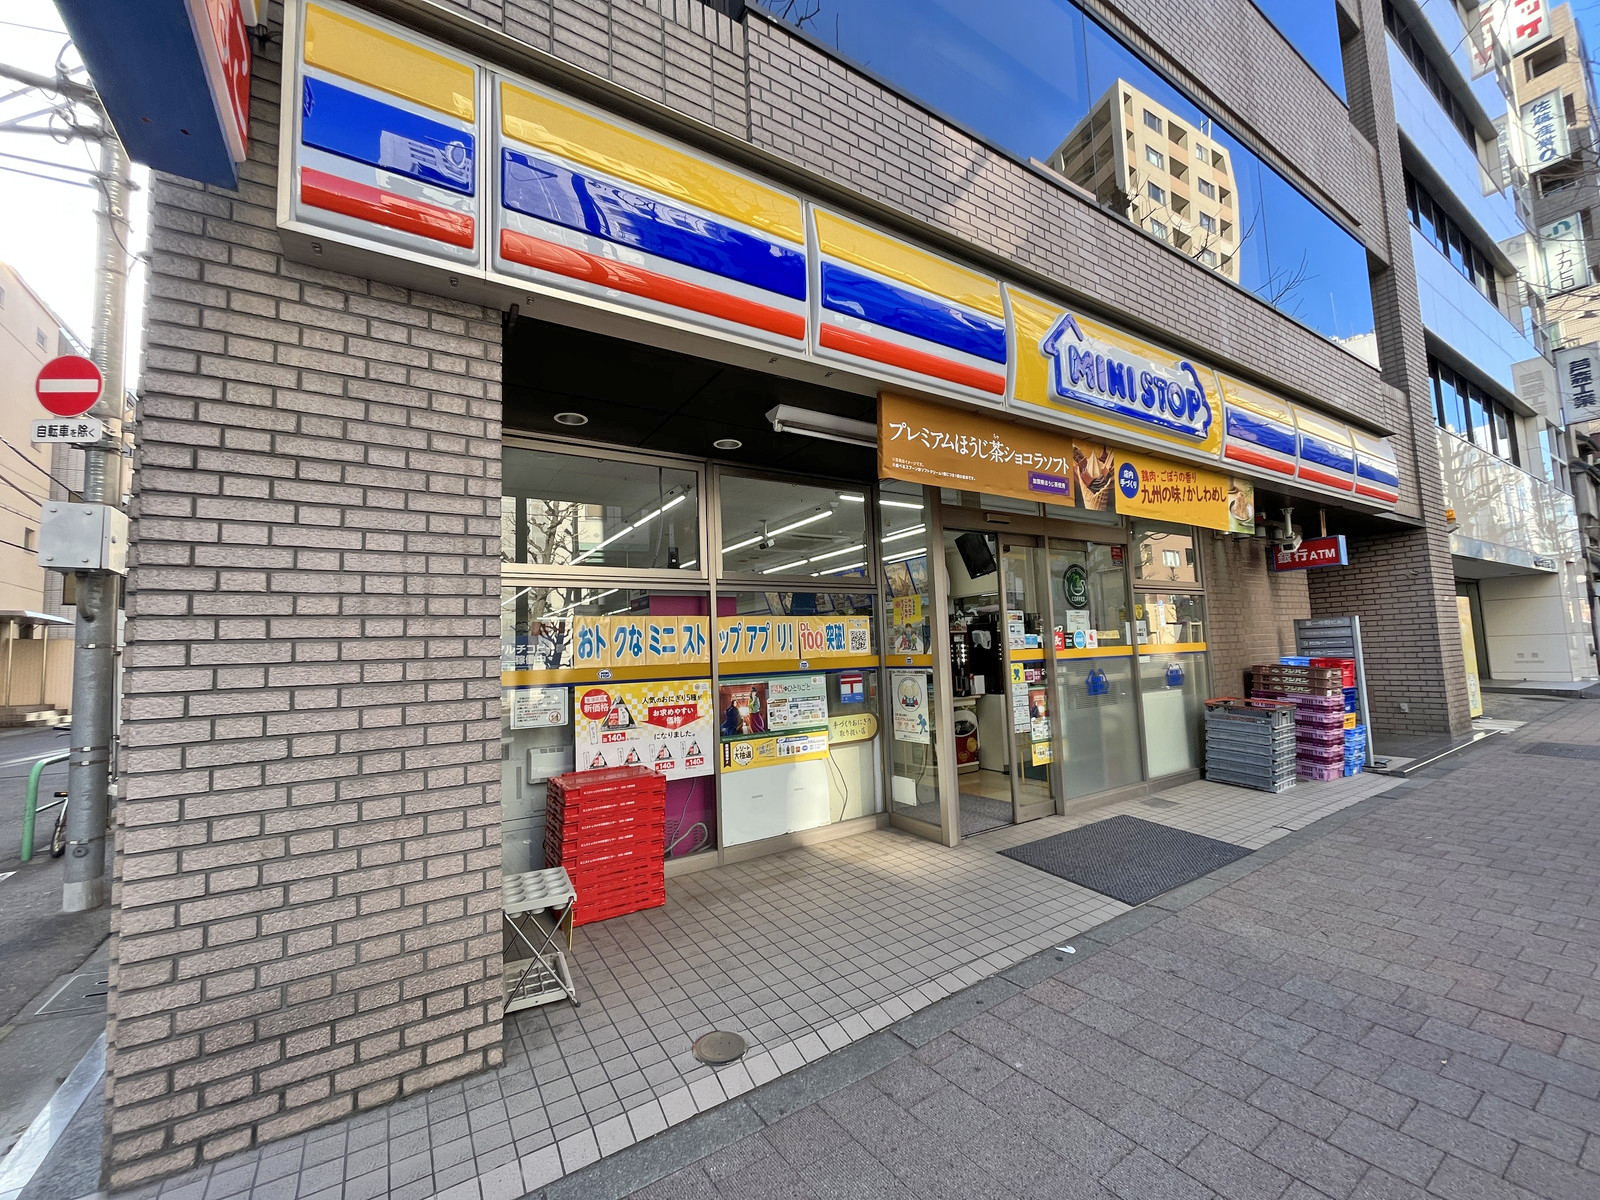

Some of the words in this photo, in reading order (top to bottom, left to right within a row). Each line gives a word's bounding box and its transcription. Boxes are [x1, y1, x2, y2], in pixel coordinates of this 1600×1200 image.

[1555, 249, 1575, 290] ナカヒロ
[1068, 344, 1138, 403] MINI
[1140, 370, 1202, 422] STOP
[36, 424, 96, 438] 自転車を除く
[888, 421, 1070, 475] プレミアムほうじ茶ショコラソフト
[1123, 469, 1134, 480] 店内
[1119, 478, 1138, 489] 手づくり
[800, 622, 811, 631] DL
[584, 703, 609, 713] 新価格
[652, 707, 694, 717] お求めやすい
[666, 716, 682, 725] 価格
[833, 718, 872, 730] 手づくりおにぎり
[653, 730, 696, 741] になりました。
